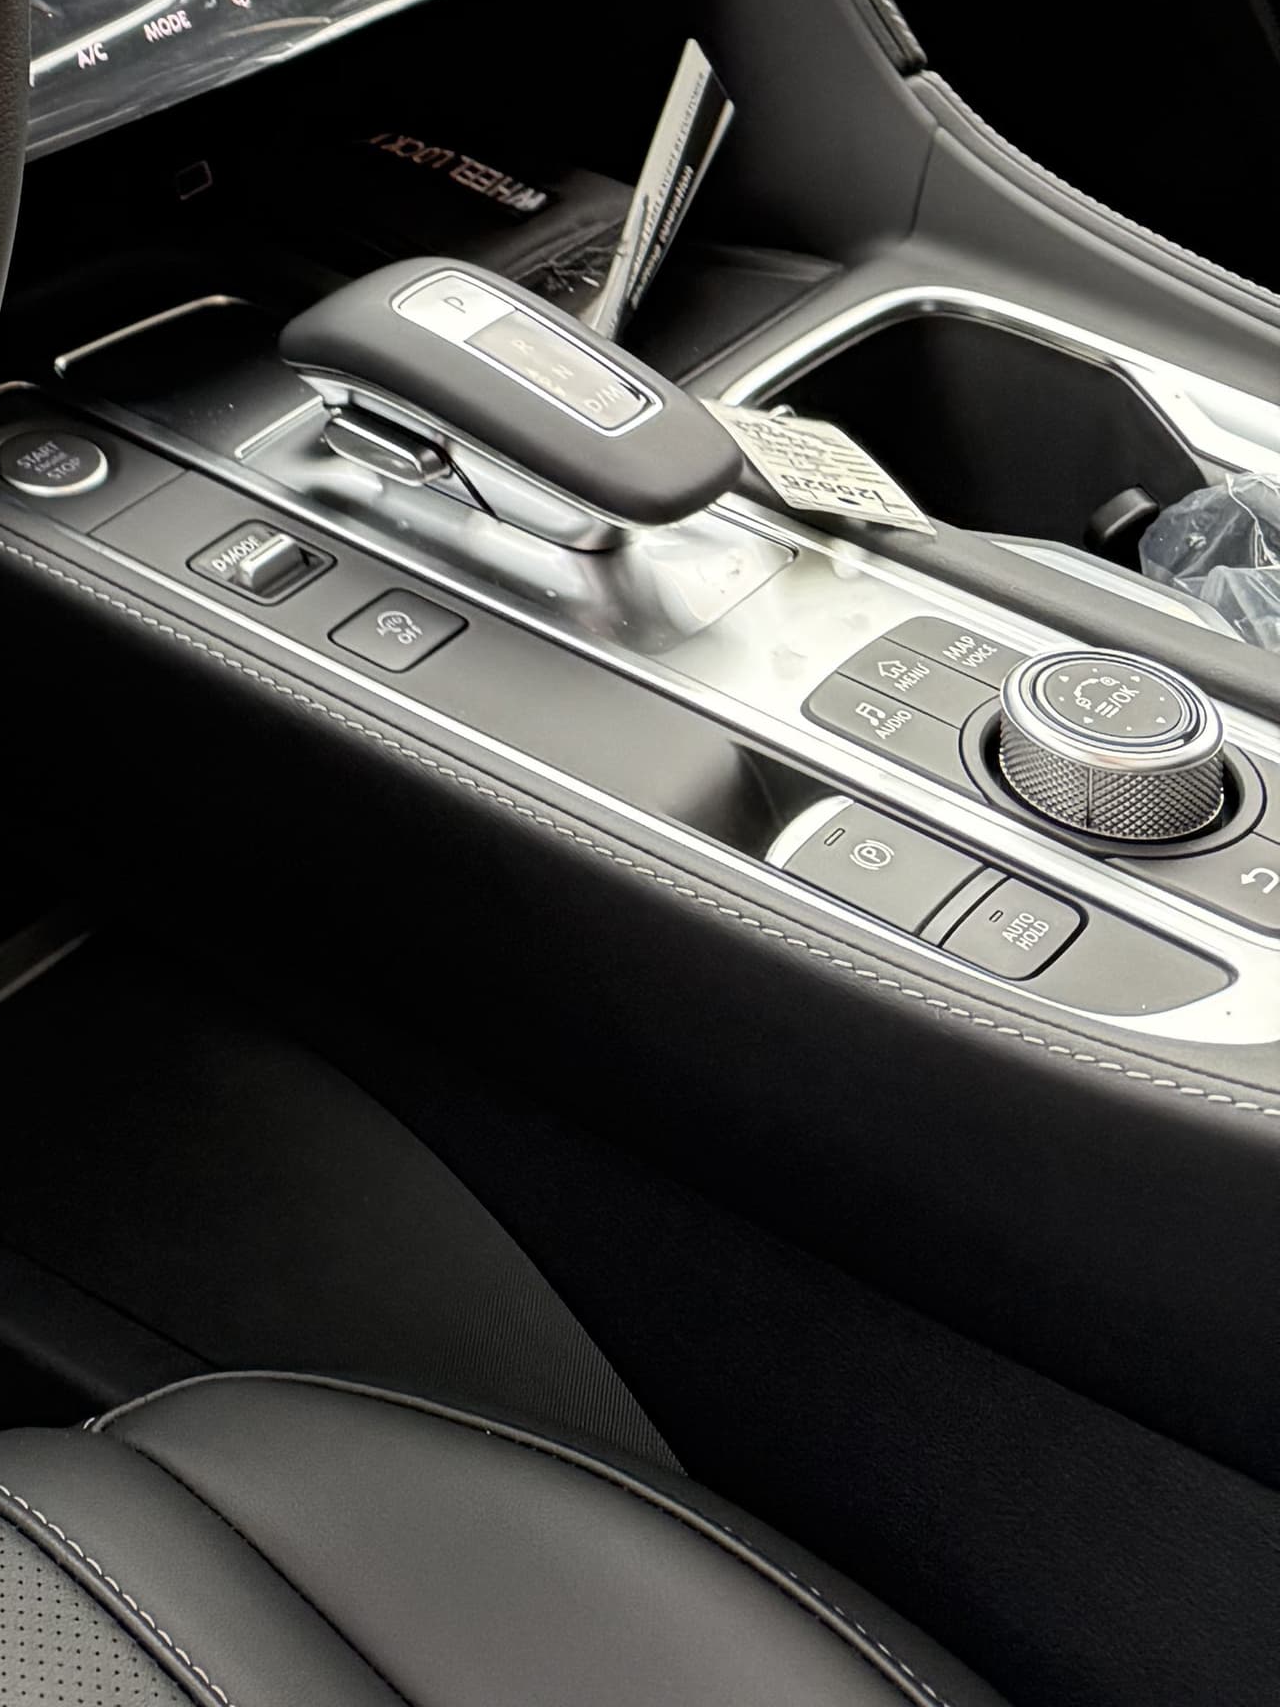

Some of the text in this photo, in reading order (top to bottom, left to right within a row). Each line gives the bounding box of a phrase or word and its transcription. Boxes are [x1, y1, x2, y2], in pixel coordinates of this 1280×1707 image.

[143, 11, 192, 44] MODE
[77, 42, 108, 70] A/C
[443, 296, 466, 314] P
[17, 440, 60, 469] START
[46, 457, 80, 480] STOP
[942, 635, 976, 661] MAP
[961, 643, 998, 668] VOICE
[894, 661, 931, 692] MENU
[874, 709, 912, 740] AUDIO
[1002, 911, 1036, 945] AUTO
[1016, 919, 1051, 952] HOLD
